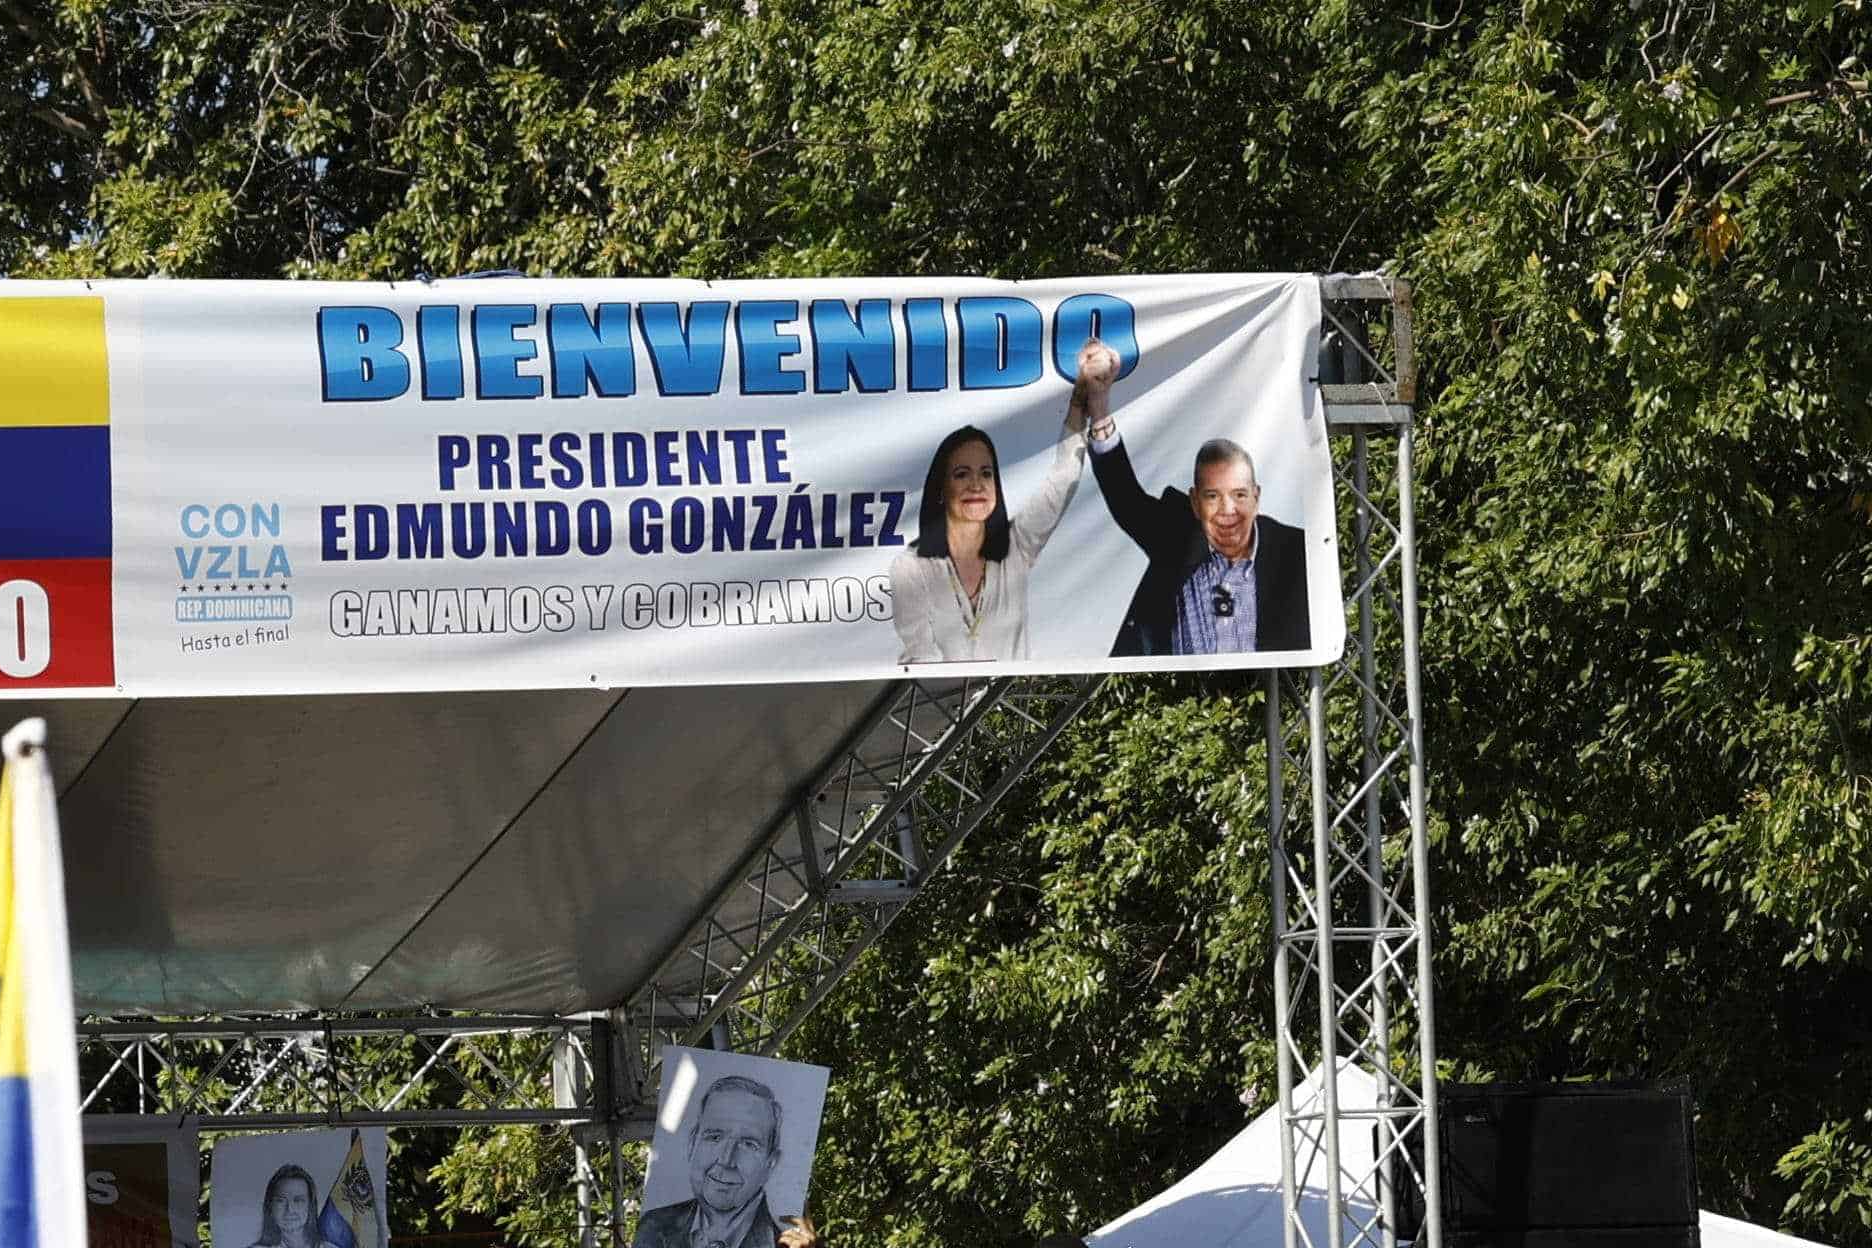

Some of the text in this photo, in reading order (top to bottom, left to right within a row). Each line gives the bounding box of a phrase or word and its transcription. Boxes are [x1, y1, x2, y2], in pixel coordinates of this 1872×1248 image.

[318, 293, 1137, 402] BIENVENIDO
[438, 429, 791, 490] PRESIDENTE
[180, 502, 281, 538] CON
[321, 483, 906, 561] EDMUNDO GONZÁLEZ
[175, 544, 292, 579] VZLA
[329, 575, 894, 637] GANAMOS Y COBRAMOS
[181, 624, 289, 652] Hasta el final
